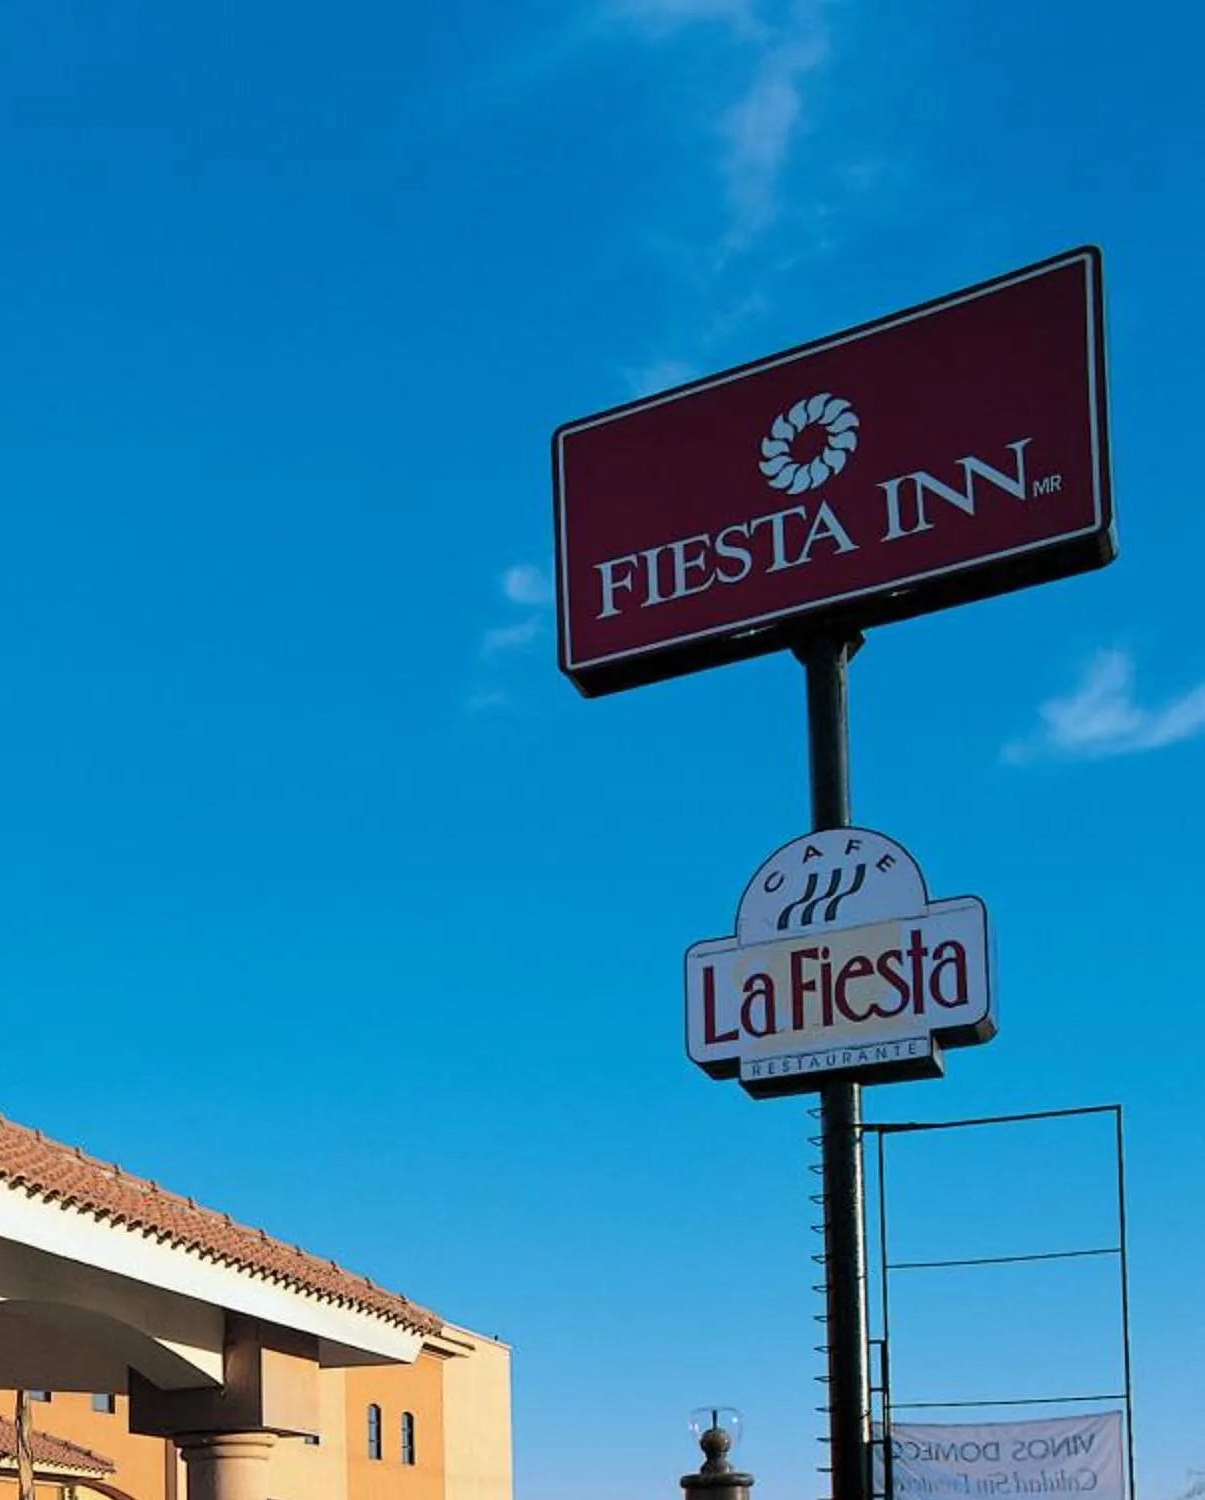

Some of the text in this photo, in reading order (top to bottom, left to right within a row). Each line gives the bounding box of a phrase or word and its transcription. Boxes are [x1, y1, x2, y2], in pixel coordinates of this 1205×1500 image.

[594, 438, 1063, 620] FIESTA INN MR
[763, 840, 896, 893] CAFE
[703, 929, 969, 1045] La Fiesta
[752, 1043, 918, 1077] RESTAURANTE
